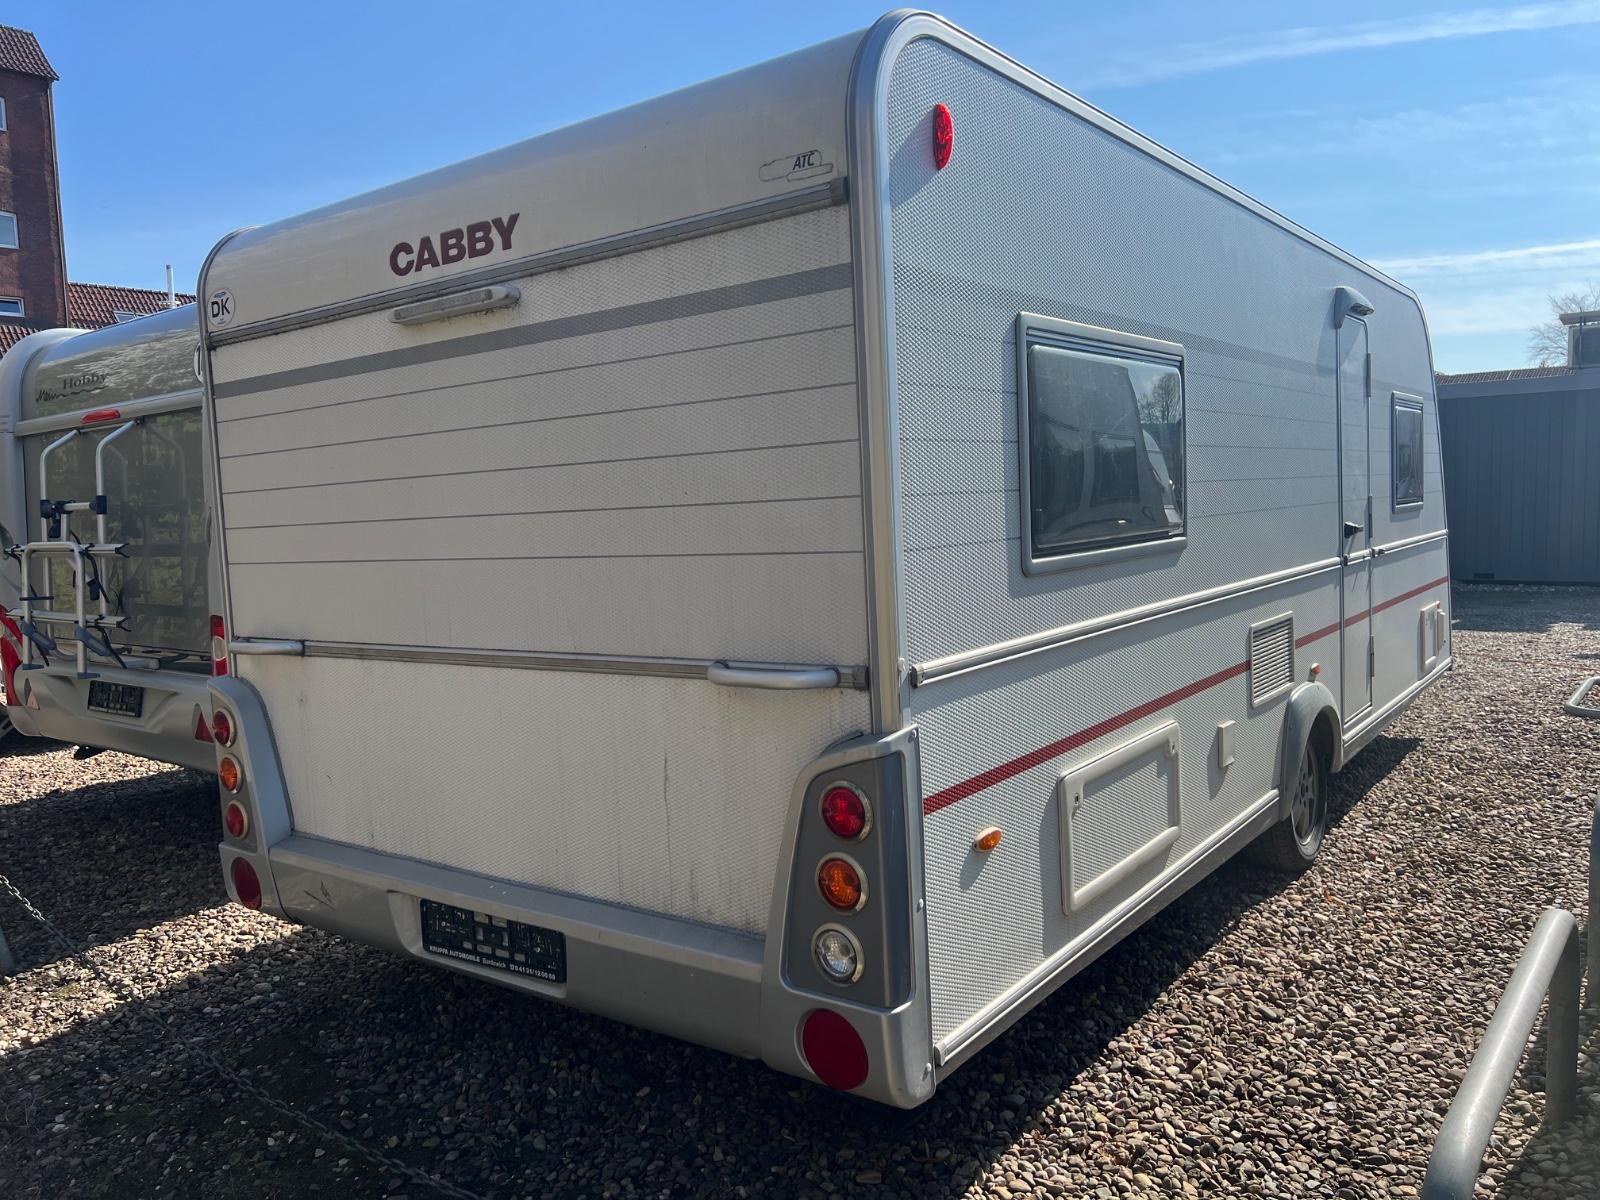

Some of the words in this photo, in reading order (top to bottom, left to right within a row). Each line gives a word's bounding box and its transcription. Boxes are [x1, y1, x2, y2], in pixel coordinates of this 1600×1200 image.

[793, 152, 815, 170] ATC
[389, 212, 520, 277] CABBY
[210, 297, 231, 318] DK
[63, 371, 107, 390] Hobby
[449, 949, 481, 963] AUTOMOBILE
